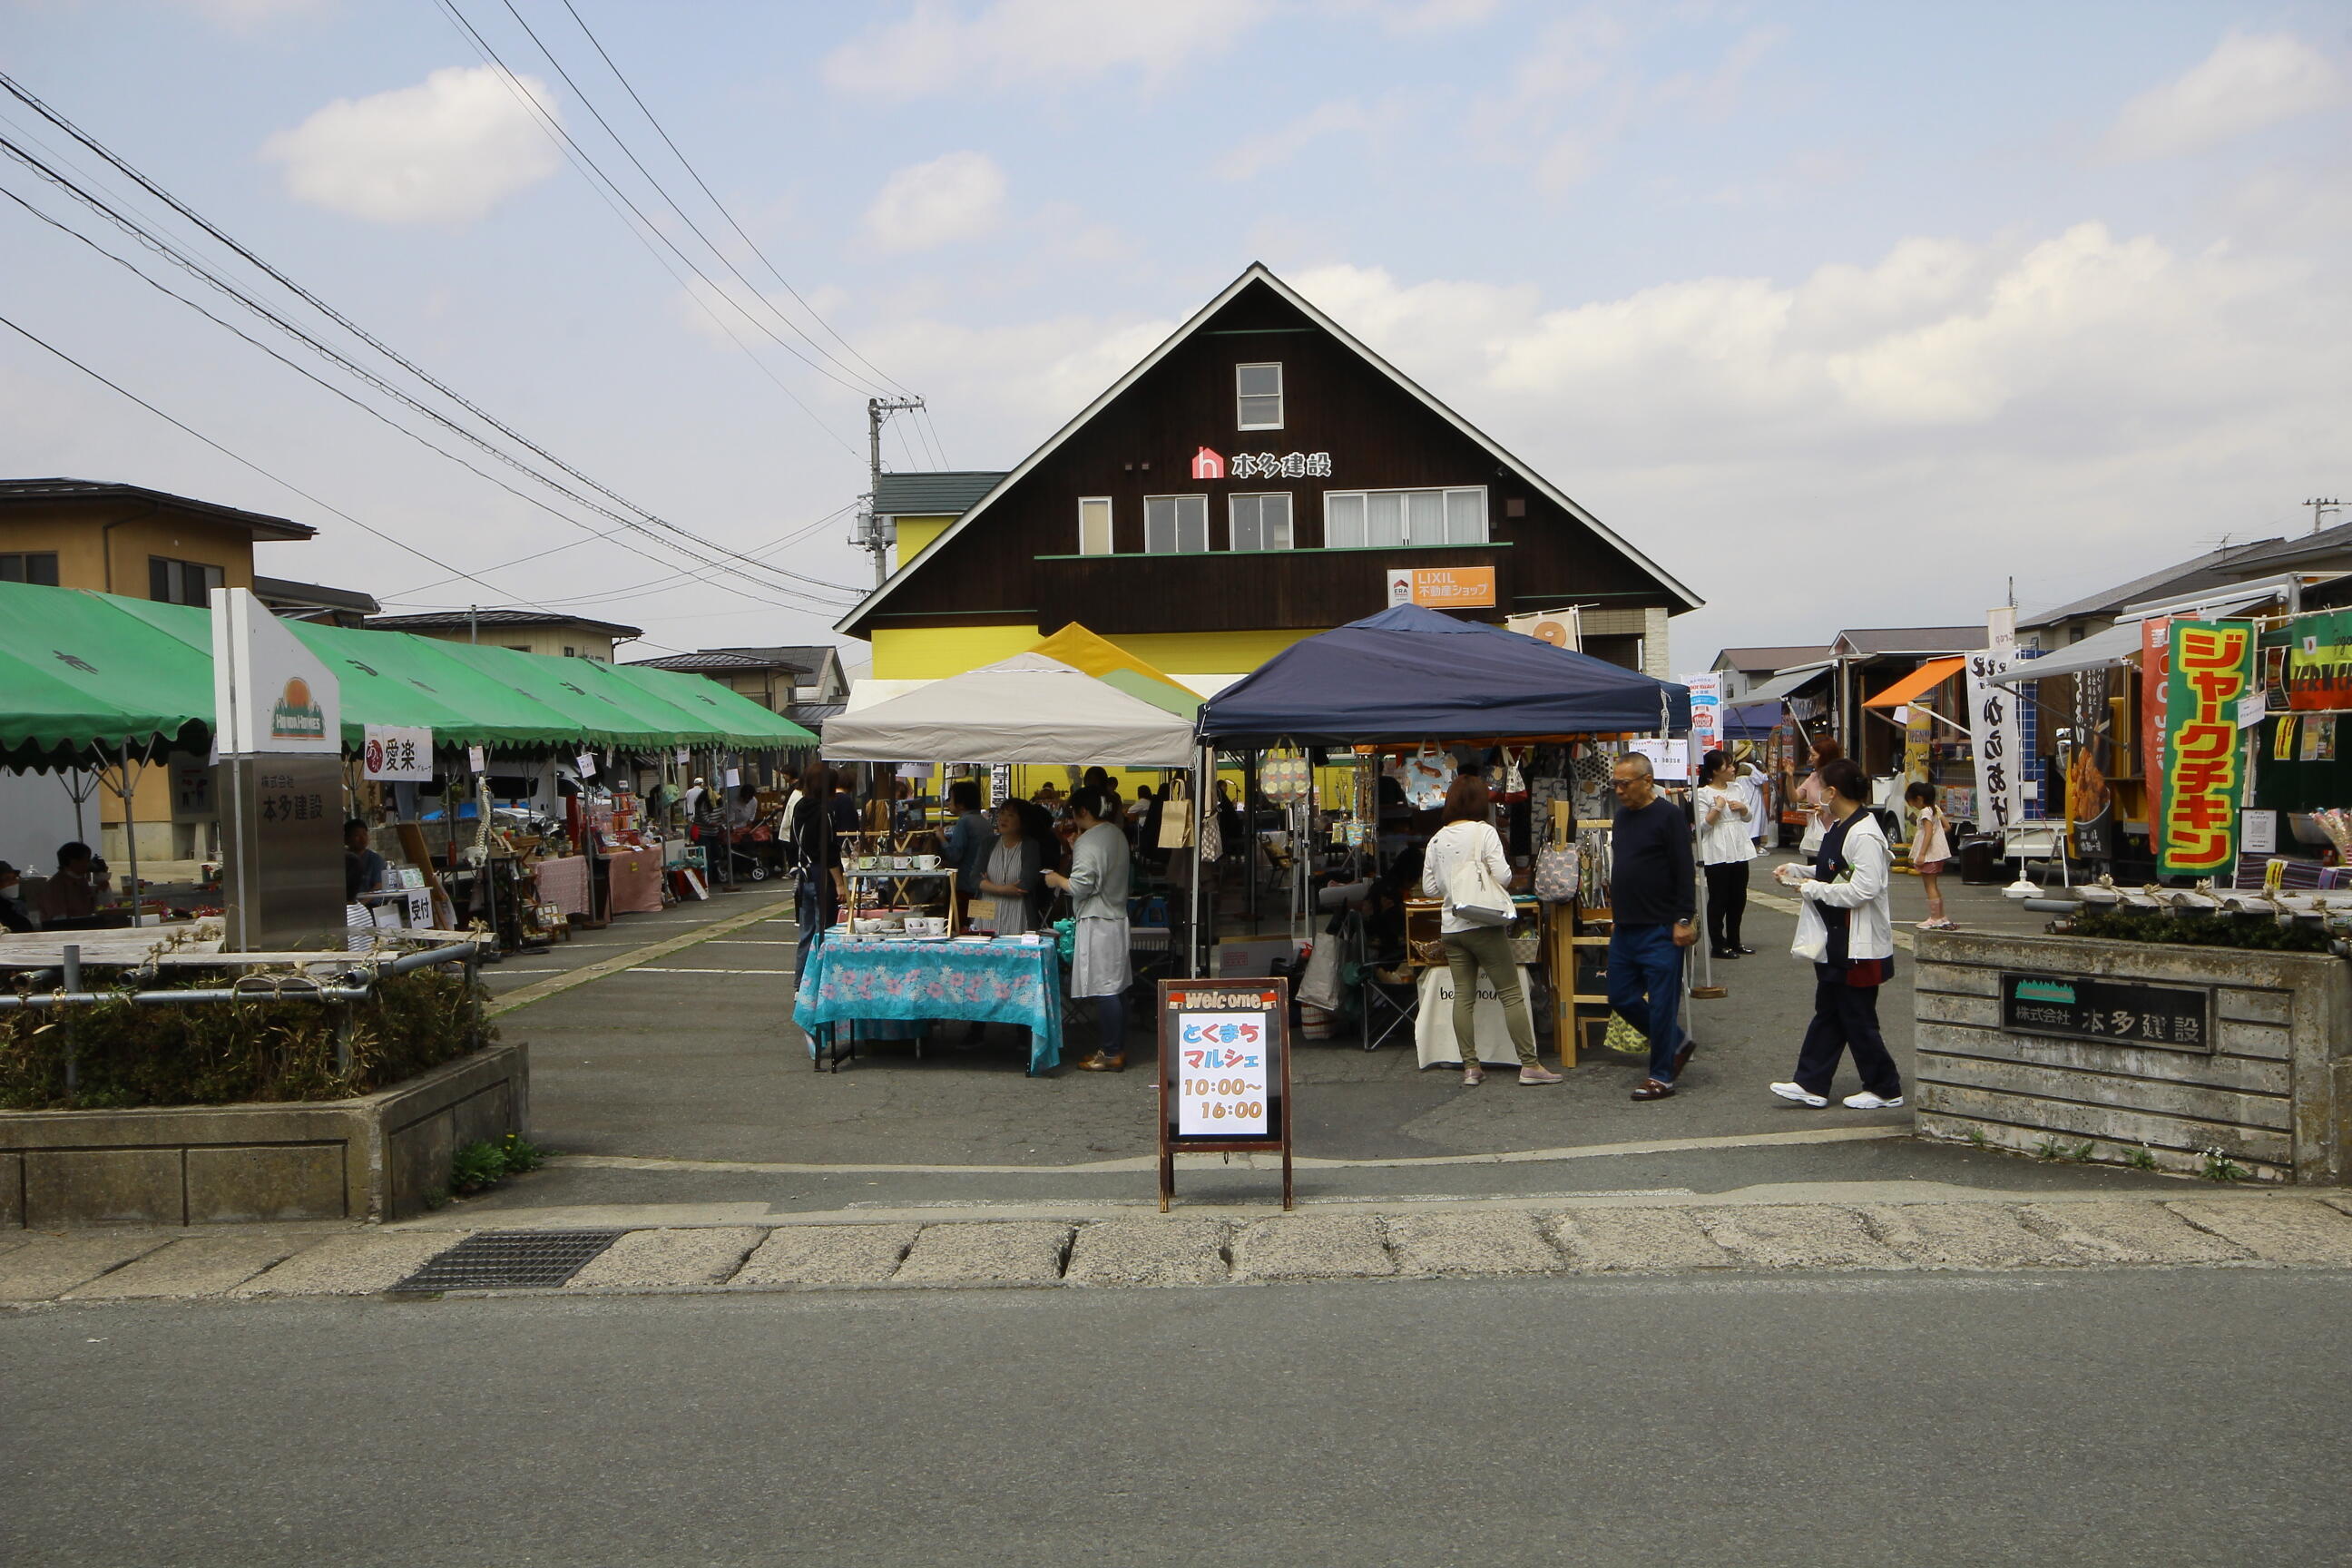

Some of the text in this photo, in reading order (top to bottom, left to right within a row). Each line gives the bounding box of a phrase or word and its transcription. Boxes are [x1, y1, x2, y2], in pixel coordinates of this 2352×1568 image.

[1231, 452, 1332, 478] 本多建設
[1418, 573, 1455, 584] LIXIL
[1418, 583, 1488, 597] 不動産ショップ
[276, 713, 320, 730] HONDA HOMES
[386, 738, 415, 771] 愛楽
[2169, 631, 2245, 865] ジャークチキン
[261, 776, 294, 789] 株式会社
[263, 794, 323, 823] 本多建設
[411, 897, 429, 922] 受付
[1185, 992, 1261, 1010] Welcome
[1183, 1024, 1259, 1043] とくまち
[2015, 1005, 2200, 1043] 株式会社 本多建設
[1184, 1049, 1259, 1069] マルシェ
[1201, 1102, 1262, 1119] 16:00
